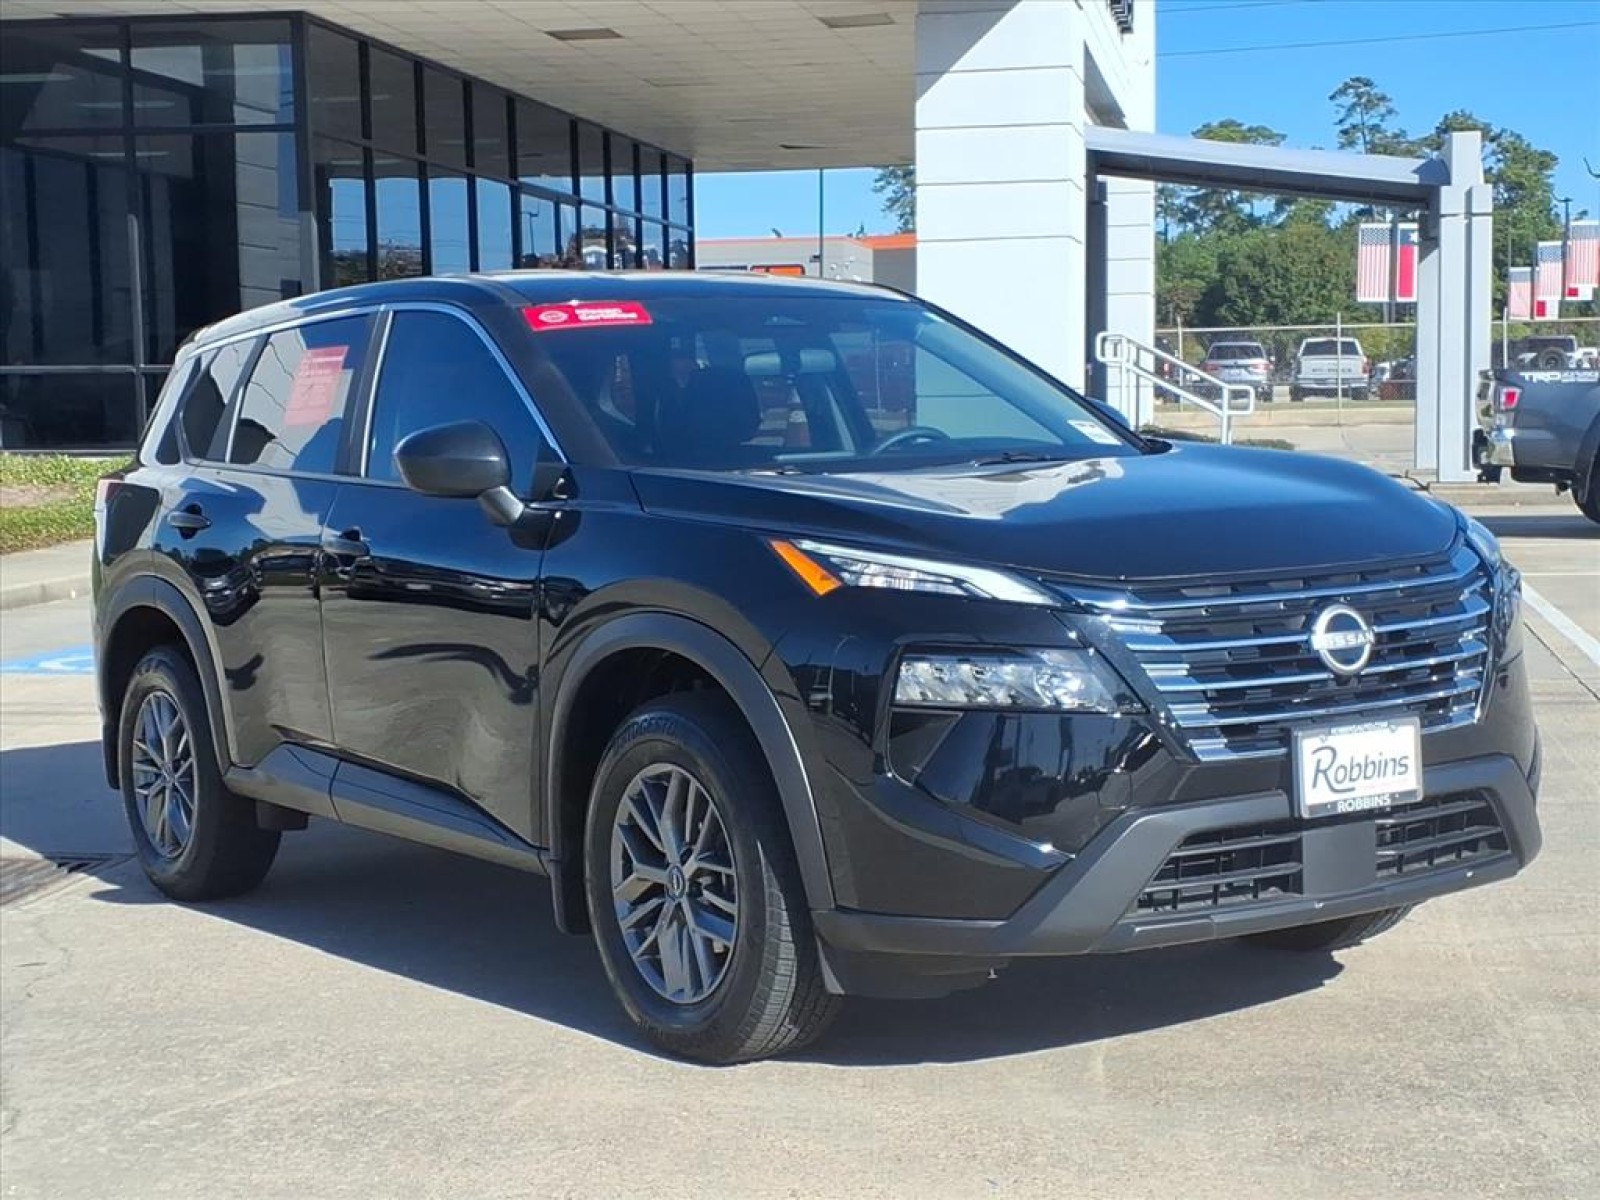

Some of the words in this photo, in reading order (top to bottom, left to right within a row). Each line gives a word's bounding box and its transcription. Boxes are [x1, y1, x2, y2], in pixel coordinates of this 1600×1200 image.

[1519, 371, 1561, 383] TRD
[1311, 745, 1409, 793] Robbins
[1337, 793, 1392, 813] ROBBINS
